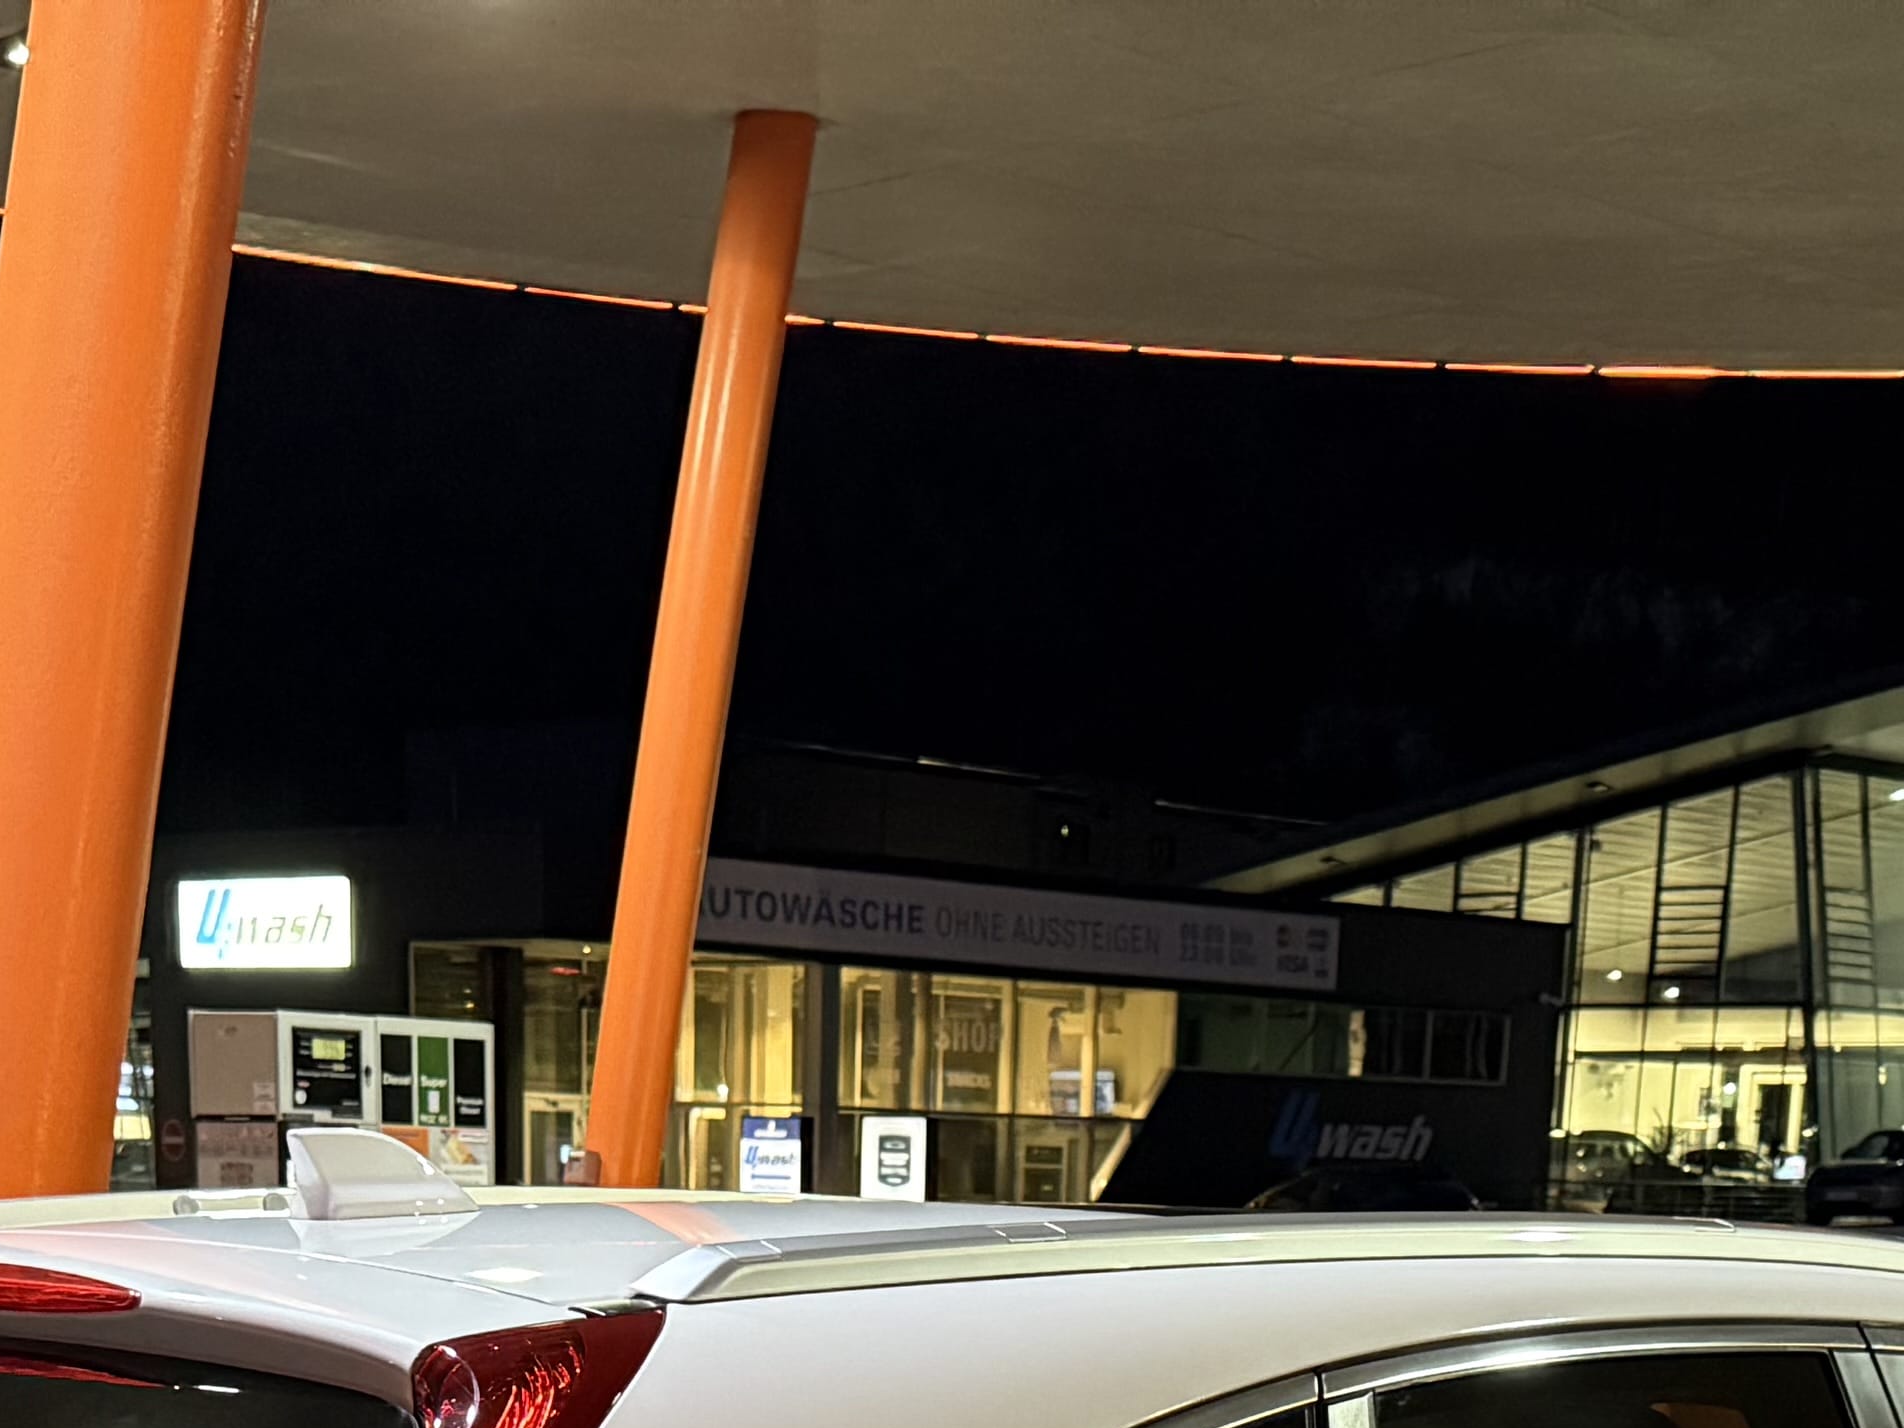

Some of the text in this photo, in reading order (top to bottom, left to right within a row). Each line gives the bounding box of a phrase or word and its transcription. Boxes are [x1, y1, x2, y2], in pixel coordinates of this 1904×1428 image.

[702, 886, 1161, 956] UTOWÄSCHE OHNE AUSSTEIGEN
[383, 1073, 412, 1085] Diesel
[420, 1075, 447, 1088] Super
